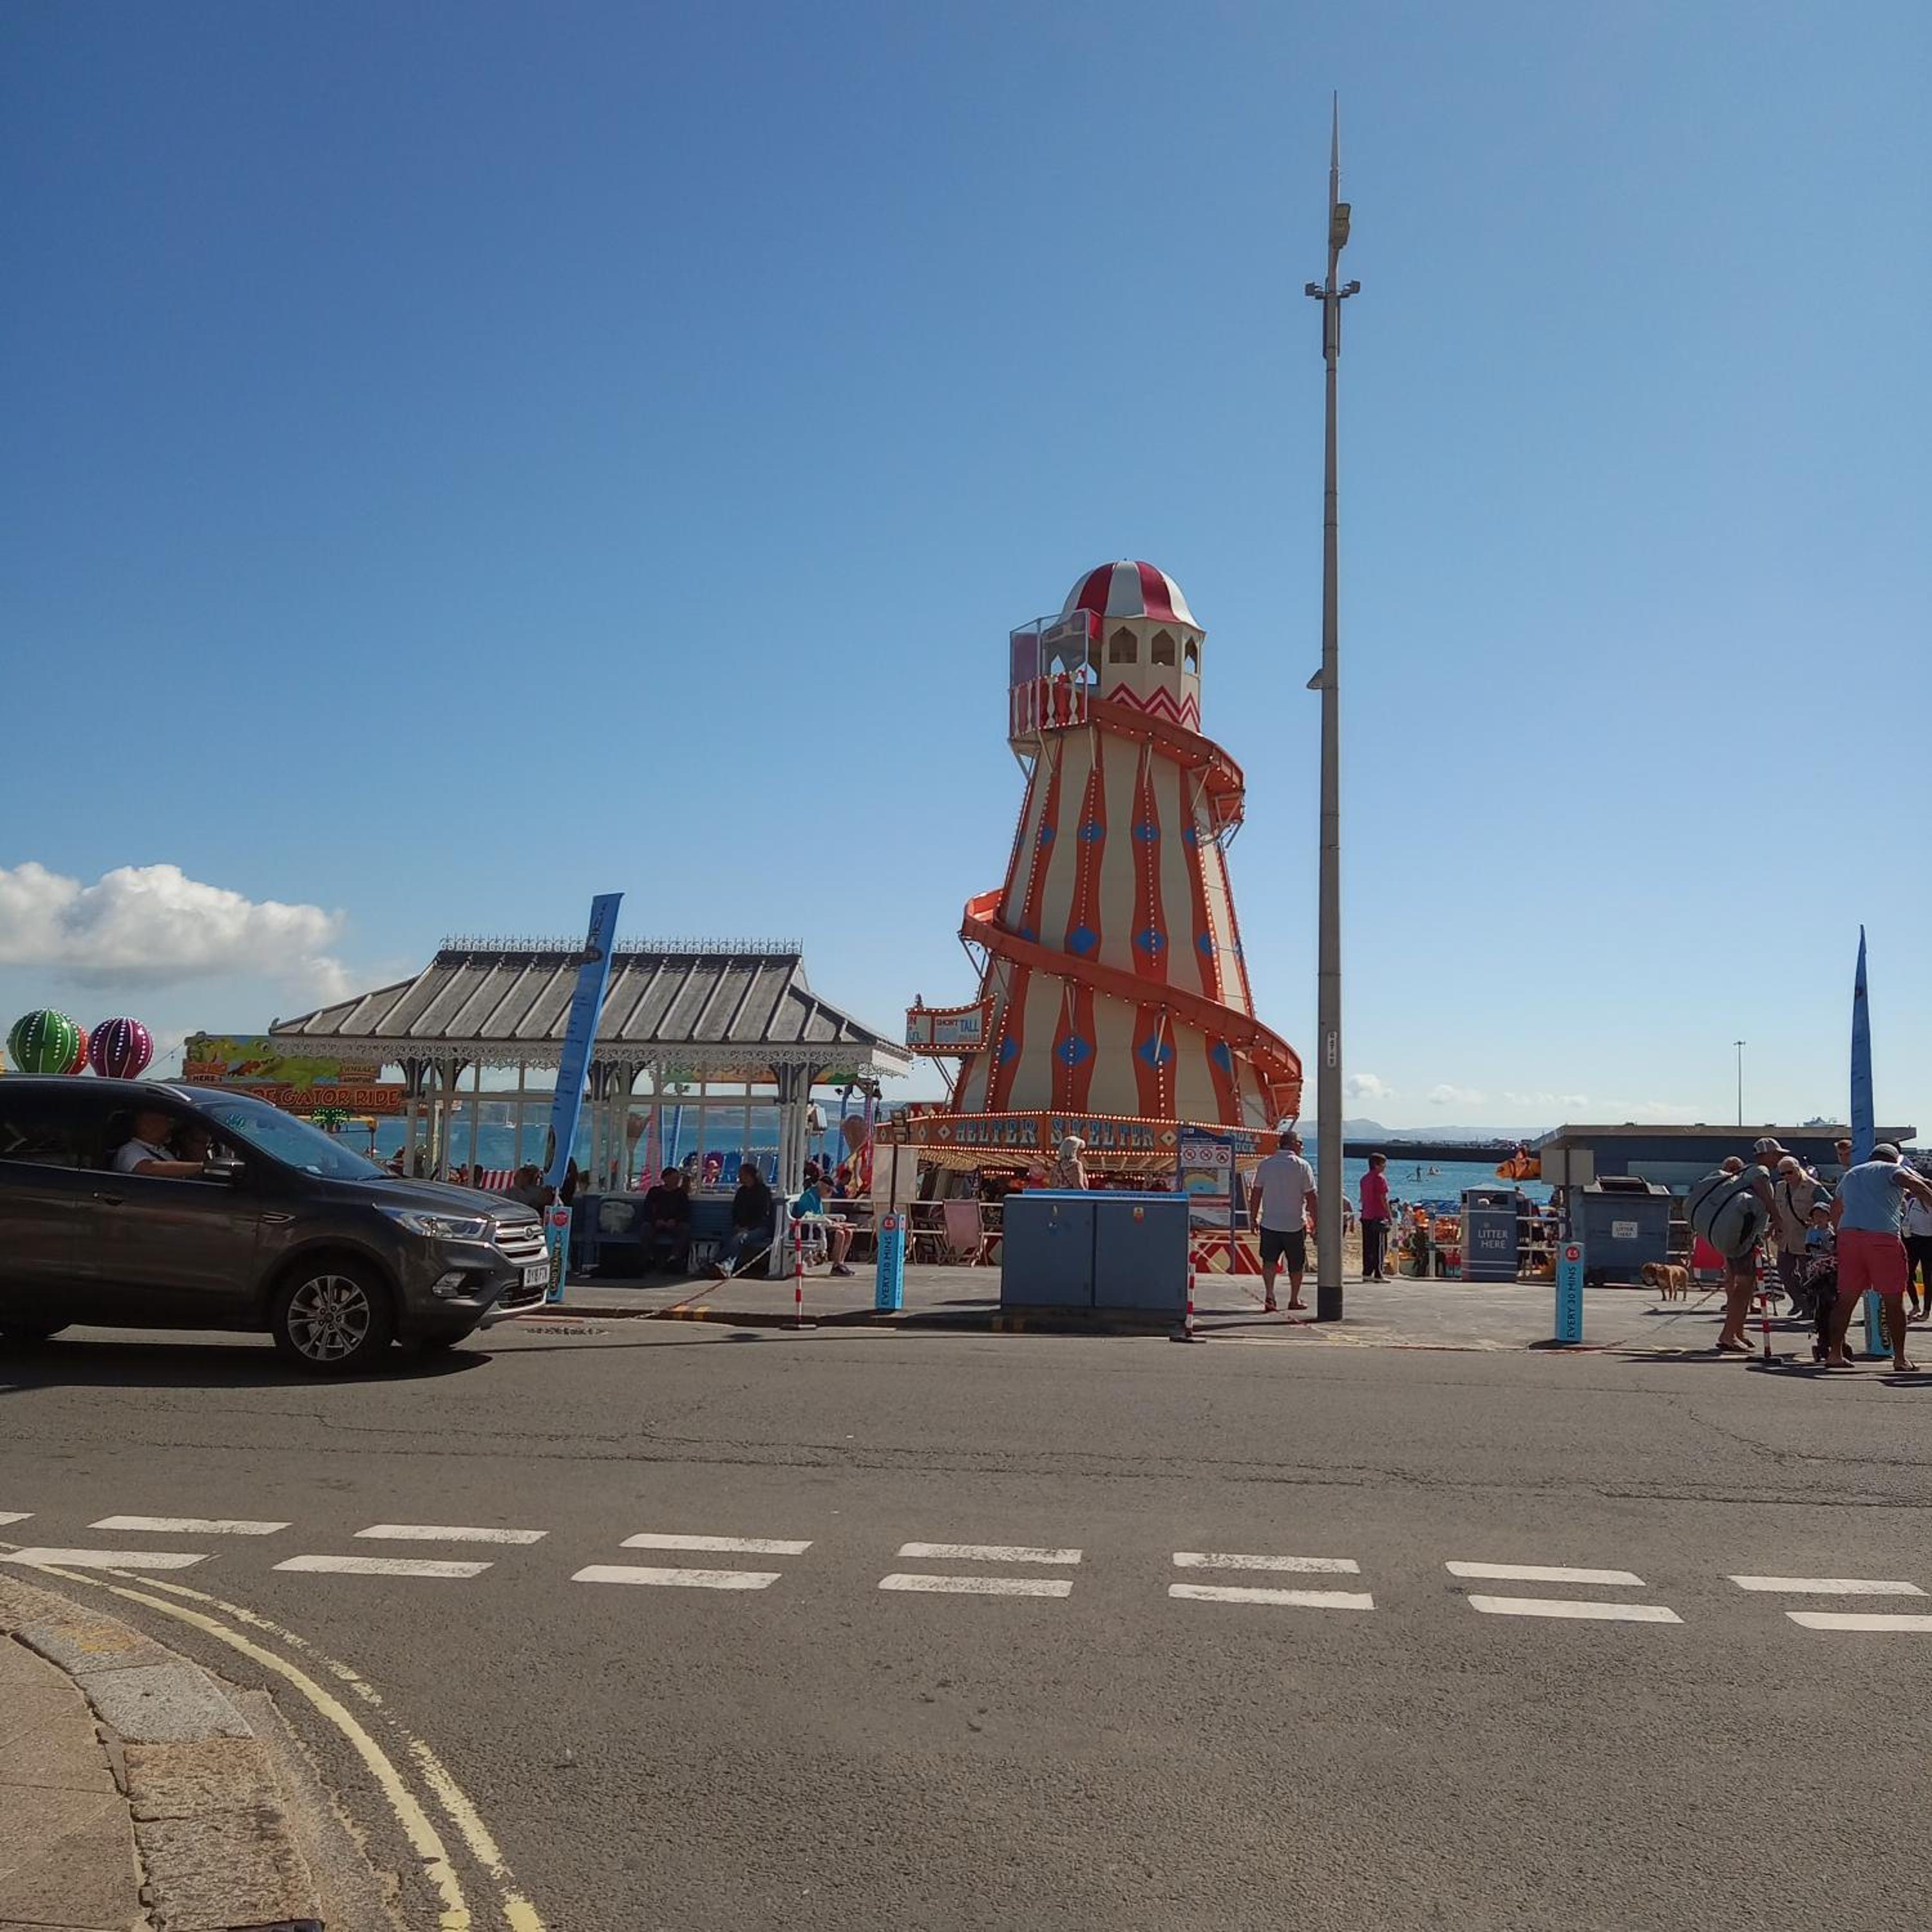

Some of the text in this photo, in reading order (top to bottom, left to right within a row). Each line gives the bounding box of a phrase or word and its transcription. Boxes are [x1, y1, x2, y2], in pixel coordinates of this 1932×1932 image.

[960, 1019, 980, 1032] TALL
[279, 1088, 350, 1106] GATOR
[354, 1088, 401, 1106] RIDE
[954, 1117, 1037, 1145] HELTER
[1478, 1228, 1508, 1238] LITTER
[1481, 1239, 1507, 1249] HERE
[884, 1236, 892, 1258] MINS
[1567, 1266, 1577, 1291] MINS
[881, 1277, 890, 1305] EVERY
[1567, 1308, 1576, 1338] EVERY
